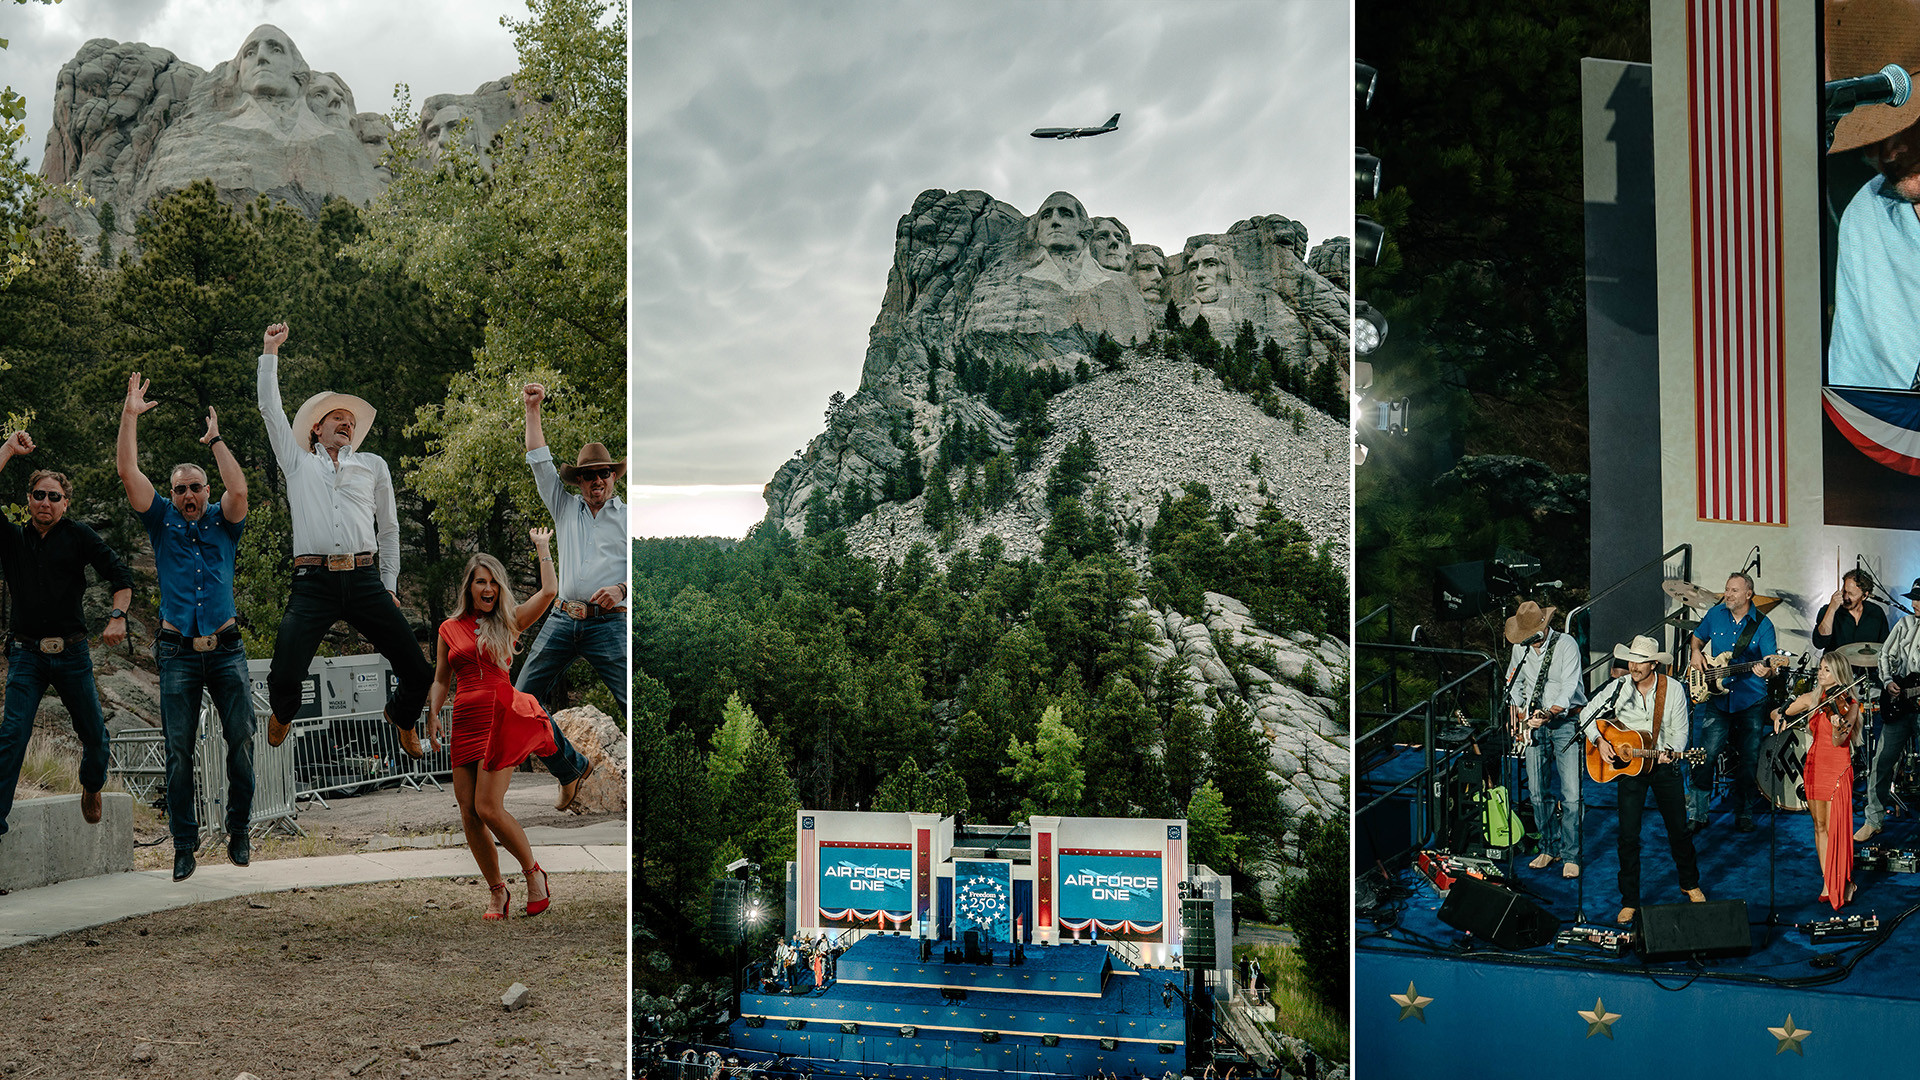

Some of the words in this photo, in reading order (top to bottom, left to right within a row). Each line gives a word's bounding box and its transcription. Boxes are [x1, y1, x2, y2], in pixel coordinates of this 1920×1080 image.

[825, 866, 852, 877] AIR
[854, 867, 911, 880] FORCE
[850, 880, 885, 891] ONE
[1064, 874, 1094, 886] AIR
[1096, 875, 1158, 888] FORCE
[1092, 888, 1130, 901] ONE
[969, 897, 997, 912] 250
